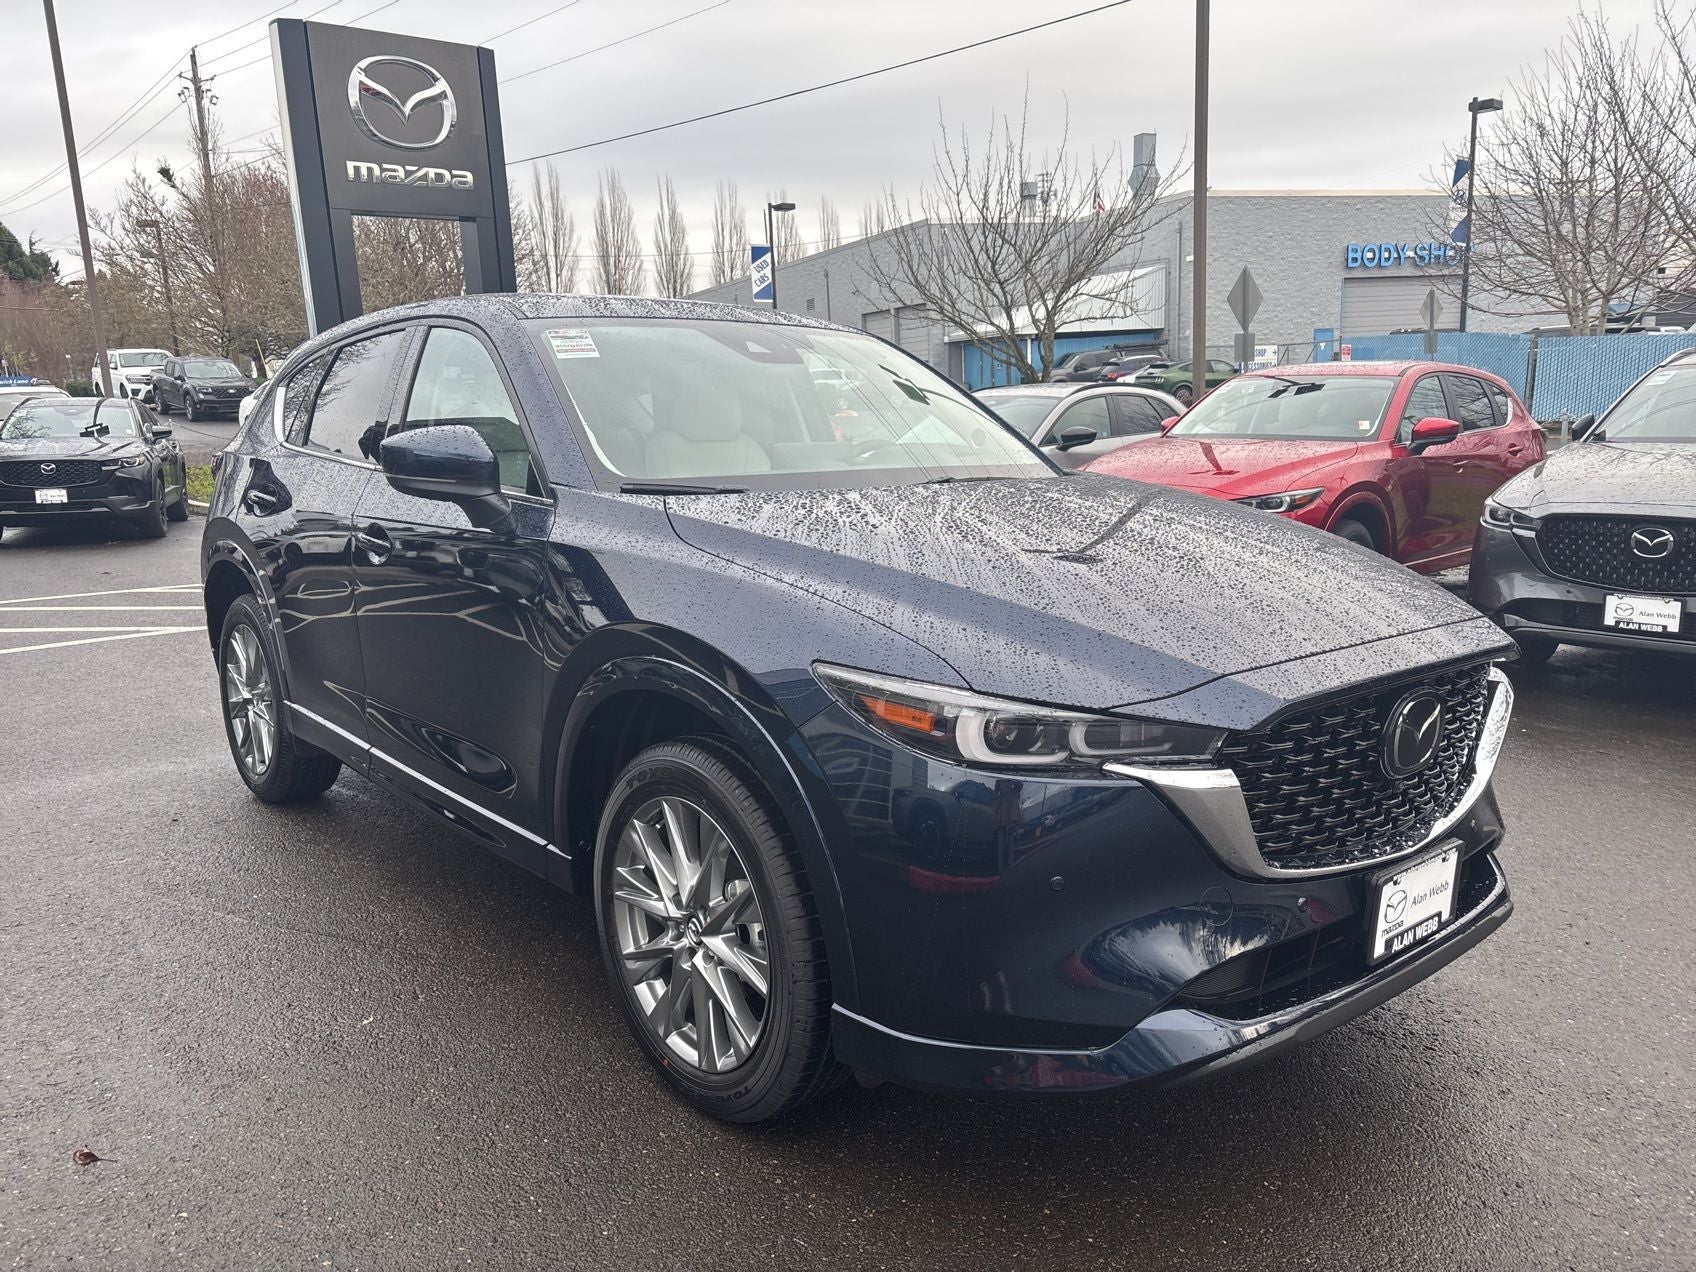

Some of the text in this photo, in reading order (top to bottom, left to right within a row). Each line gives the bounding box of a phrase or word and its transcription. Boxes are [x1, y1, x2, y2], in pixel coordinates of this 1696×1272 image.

[1346, 242, 1473, 268] BODY SHO
[753, 259, 770, 274] USED
[754, 272, 770, 288] CARS
[1638, 610, 1677, 620] Alan Webb
[1618, 621, 1663, 632] ALAN WEBB
[1410, 880, 1449, 908] Alan Webb
[1391, 916, 1439, 953] ALAN WEBB
